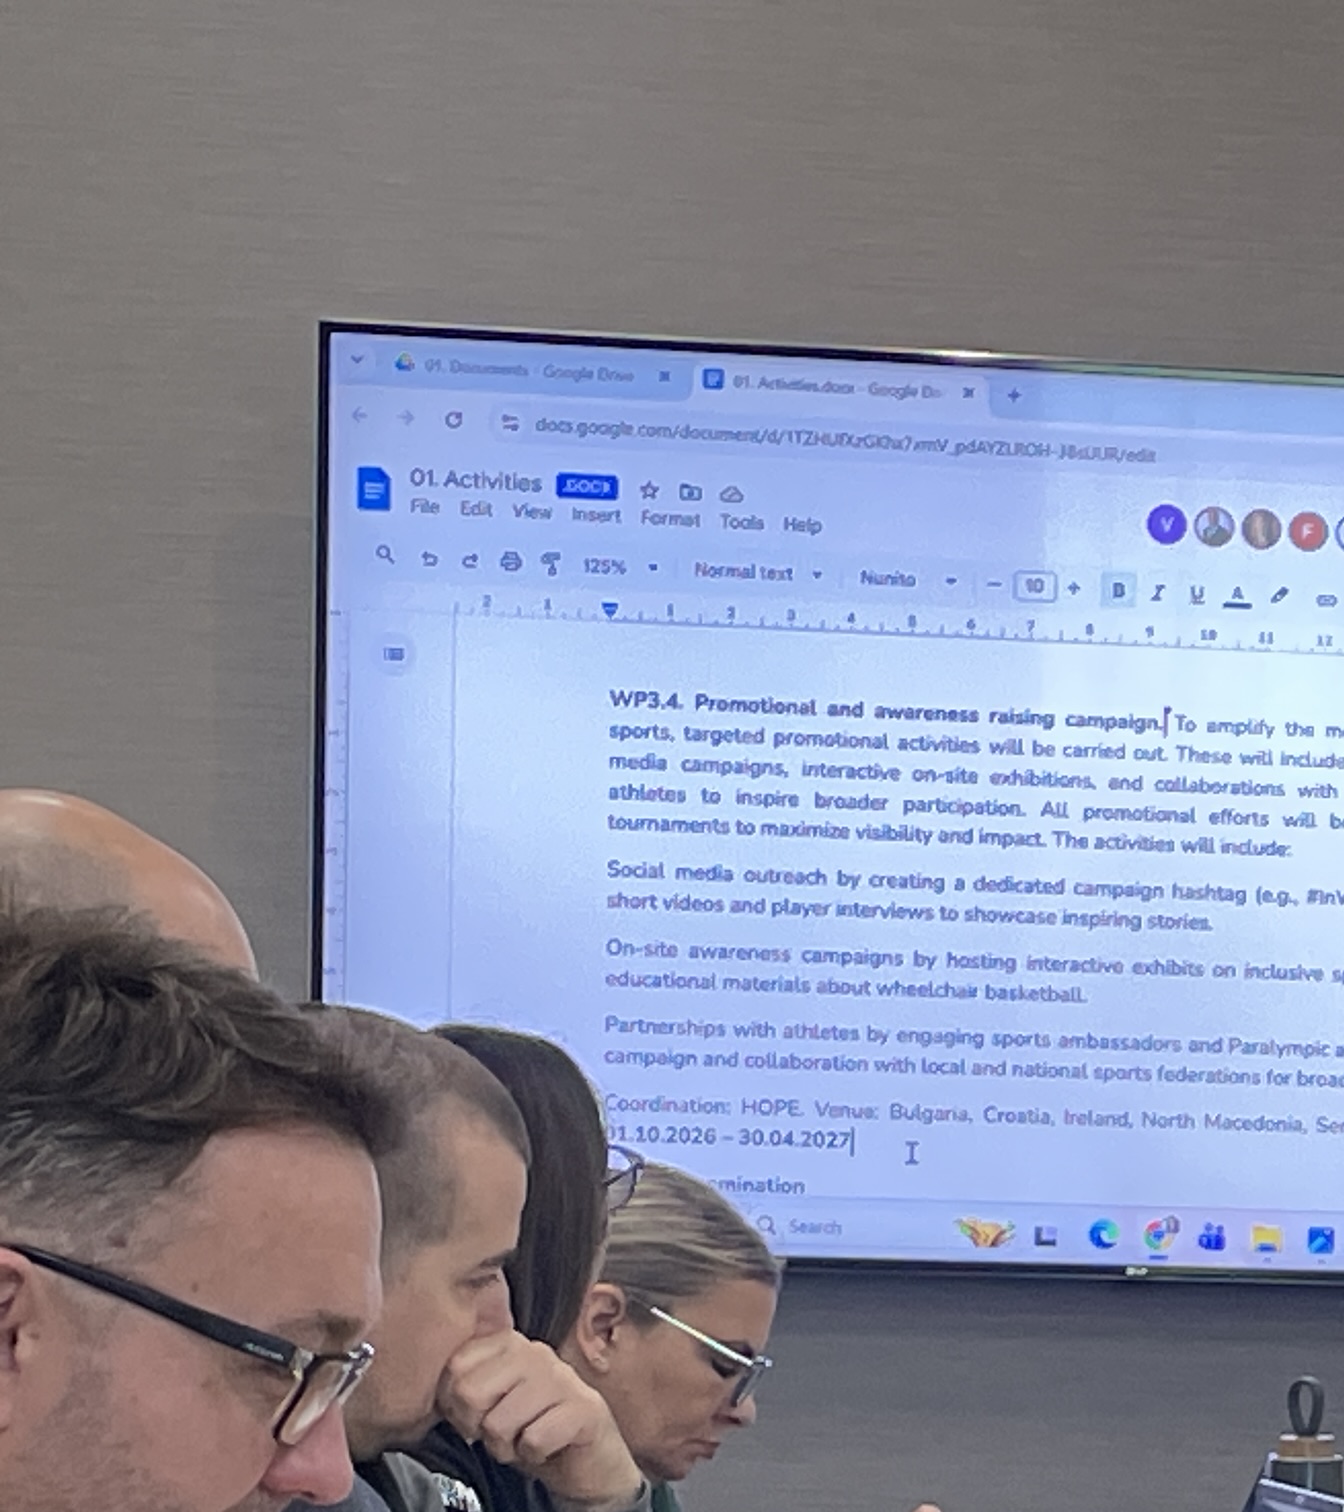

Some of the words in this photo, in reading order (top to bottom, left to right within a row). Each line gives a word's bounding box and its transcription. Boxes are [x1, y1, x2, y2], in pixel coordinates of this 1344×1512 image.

[410, 467, 438, 488] 01.
[443, 470, 543, 493] Activities
[410, 498, 440, 515] File
[460, 500, 493, 517] Edit
[512, 503, 553, 520] View
[572, 506, 622, 524] Insert
[640, 509, 701, 528] Format
[719, 513, 765, 530] Tools
[783, 517, 823, 536] Help
[583, 558, 627, 576] 125%
[694, 561, 756, 580] Normal
[760, 565, 794, 582] text
[609, 690, 685, 710] WP3.4.
[694, 693, 818, 716] Promotional
[826, 701, 865, 718] and
[873, 706, 980, 723] awareness
[988, 708, 1056, 730] raising
[1064, 711, 1163, 734] campaign.
[1174, 714, 1198, 733] To
[1206, 719, 1276, 739] amplify
[1284, 722, 1315, 737] the
[609, 724, 676, 745] sports,
[683, 726, 766, 747] targeted
[772, 732, 890, 753] promotional
[896, 735, 981, 754] activities
[988, 738, 1025, 755] will
[1031, 740, 1056, 757] be
[1062, 743, 1126, 759] carried
[1132, 747, 1169, 761] out.
[1175, 745, 1233, 765] These
[1238, 750, 1274, 766] will
[608, 753, 668, 771] media
[679, 759, 790, 779] campaigns,
[800, 762, 903, 782] interactive
[911, 767, 980, 784] on-site
[988, 769, 1098, 790] exhibitions,
[1107, 775, 1145, 792] and
[1153, 776, 1287, 796] collaborations
[1296, 783, 1340, 798] with
[607, 784, 687, 803] athletes
[699, 788, 722, 804] to
[734, 789, 800, 809] inspire
[813, 792, 890, 811] broader
[902, 798, 1028, 817] participation.
[1039, 800, 1070, 819] All
[1081, 806, 1197, 826] promotional
[1207, 808, 1270, 827] efforts
[1281, 812, 1318, 828] will
[607, 815, 731, 835] tournaments
[734, 820, 757, 835] to
[760, 821, 851, 839] maximize
[855, 824, 934, 846] visibility
[937, 828, 974, 845] and
[978, 827, 1048, 849] impact.
[1051, 831, 1089, 849] The
[1093, 833, 1175, 852] activities
[1180, 837, 1216, 854] will
[1220, 839, 1291, 857] include:
[607, 860, 666, 879] Social
[674, 864, 735, 882] media
[742, 868, 828, 886] outreach
[836, 870, 862, 891] by
[867, 873, 946, 895] creating
[953, 878, 966, 891] a
[972, 876, 1066, 895] dedicated
[1072, 882, 1165, 902] campaign
[1171, 883, 1247, 906] hashtag
[607, 892, 658, 910] short
[662, 893, 725, 912] videos
[729, 898, 767, 914] and
[770, 898, 832, 918] player
[835, 901, 935, 921] interviews
[938, 906, 960, 921] to
[964, 906, 1058, 925] showcase
[1061, 909, 1143, 932] inspiring
[1147, 913, 1213, 931] stories.
[605, 938, 679, 958] On-site
[687, 946, 793, 963] awareness
[800, 948, 904, 969] campaigns
[912, 950, 939, 971] by
[945, 952, 1018, 974] hosting
[1025, 955, 1125, 974] interactive
[1130, 959, 1206, 977] exhibits
[1211, 965, 1237, 978] on
[1243, 962, 1325, 982] inclusive
[604, 1015, 727, 1039] Partnerships
[732, 1021, 777, 1038] with
[782, 1024, 861, 1041] athletes
[866, 1025, 891, 1046] by
[895, 1028, 985, 1050] engaging
[990, 1033, 1052, 1052] sports
[1056, 1032, 1183, 1052] ambassadors
[1187, 1037, 1225, 1054] and
[1227, 1037, 1331, 1059] Paralympic
[603, 1049, 698, 1070] campaign
[702, 1051, 740, 1067] and
[744, 1052, 869, 1071] collaboration
[873, 1056, 917, 1073] with
[920, 1057, 967, 1075] local
[970, 1060, 1007, 1077] and
[1011, 1061, 1089, 1079] national
[1093, 1066, 1153, 1086] sports
[1156, 1065, 1262, 1085] federations
[1265, 1069, 1293, 1086] for
[737, 1129, 850, 1152] 30.04.2027
[789, 1218, 843, 1236] Search
